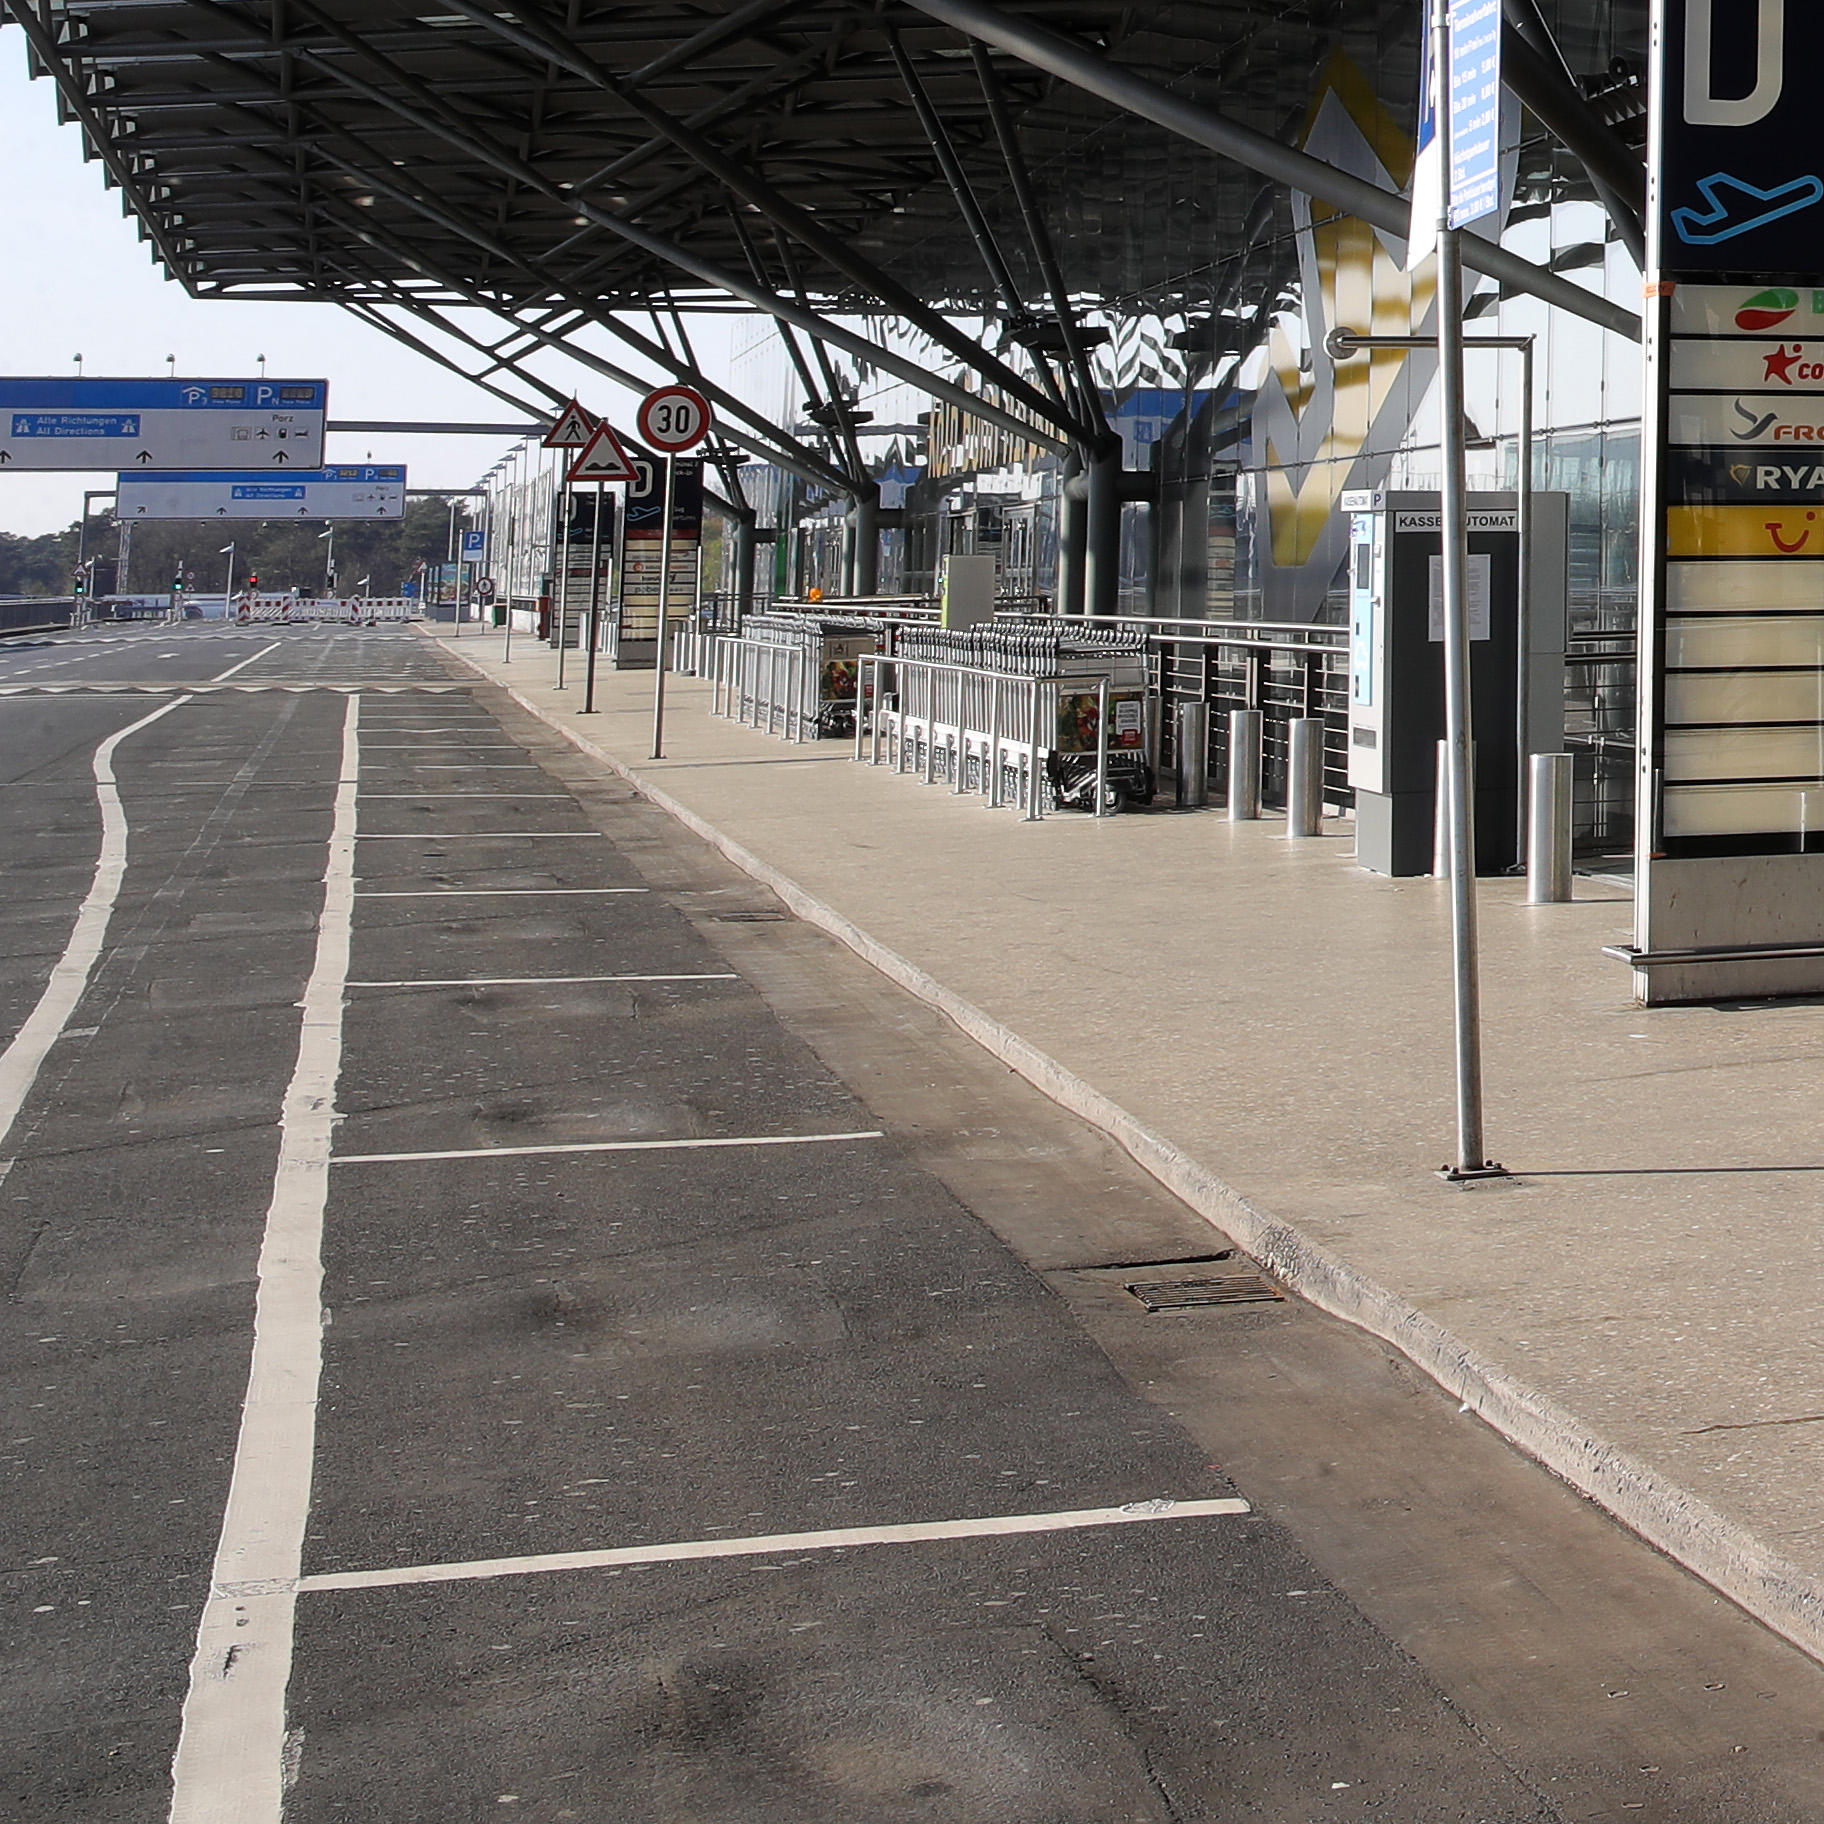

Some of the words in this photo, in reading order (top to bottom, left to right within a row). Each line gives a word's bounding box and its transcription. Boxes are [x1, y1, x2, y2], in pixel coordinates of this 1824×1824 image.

[37, 416, 57, 425] Alle
[61, 416, 117, 427] Richtungen
[272, 414, 294, 423] Porz
[657, 405, 690, 434] 30
[37, 427, 51, 436] All
[54, 427, 105, 436] Directions
[1374, 493, 1382, 507] P
[468, 533, 481, 549] P
